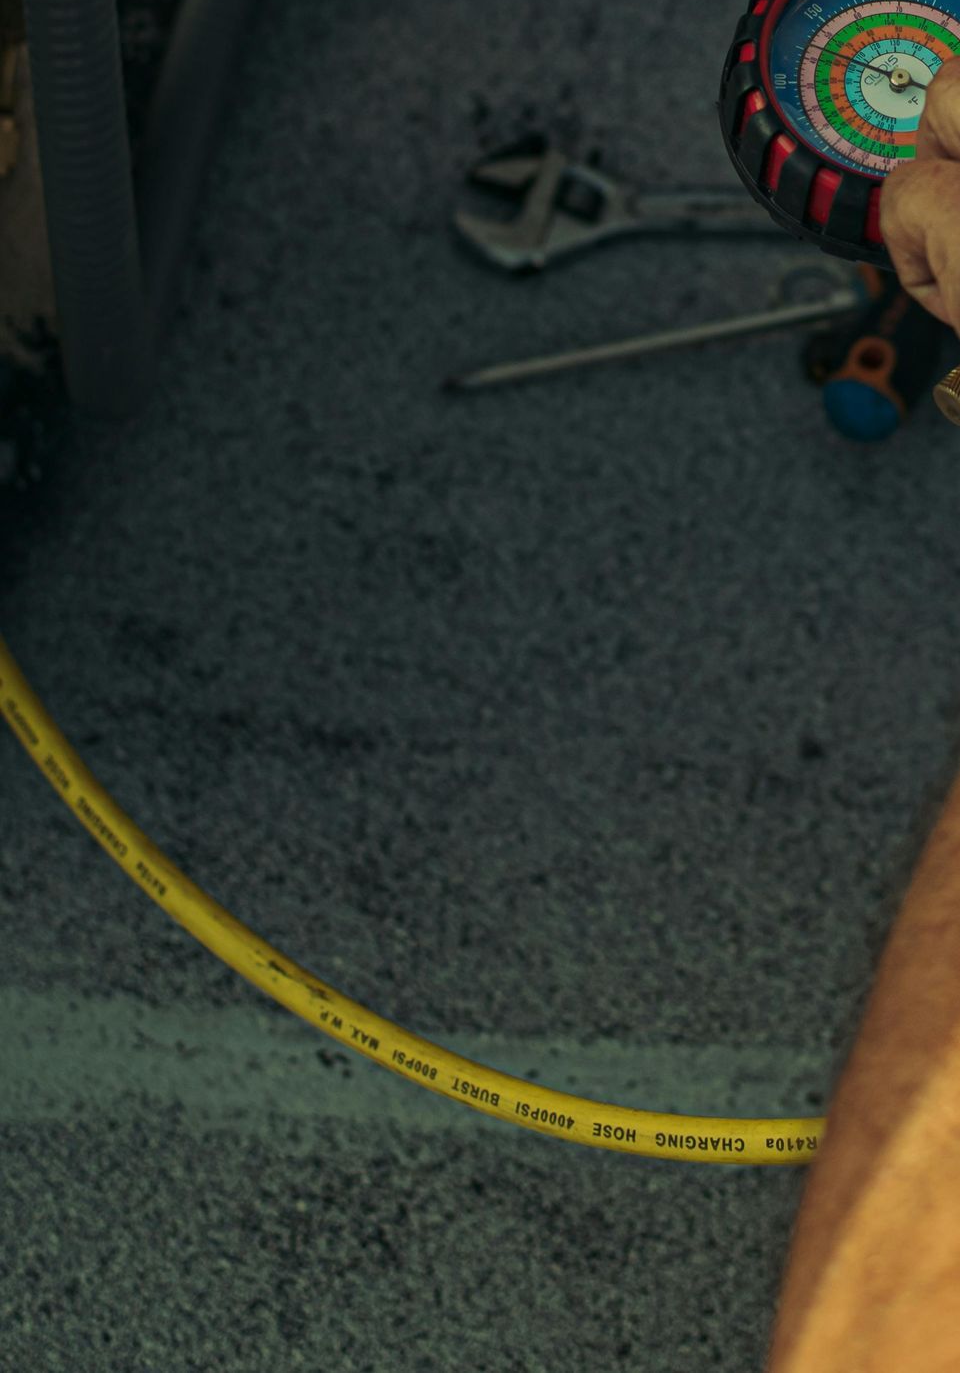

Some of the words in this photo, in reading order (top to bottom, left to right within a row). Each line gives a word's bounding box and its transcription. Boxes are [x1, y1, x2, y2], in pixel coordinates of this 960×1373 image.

[775, 73, 786, 90] 100
[804, 3, 822, 19] 150
[392, 1049, 438, 1080] 800PSI
[451, 1077, 501, 1107] BURST
[515, 1101, 576, 1130] 4000PSI
[592, 1122, 636, 1143] HOSE
[655, 1132, 745, 1152] CHARGING
[766, 1136, 818, 1152] R410a
